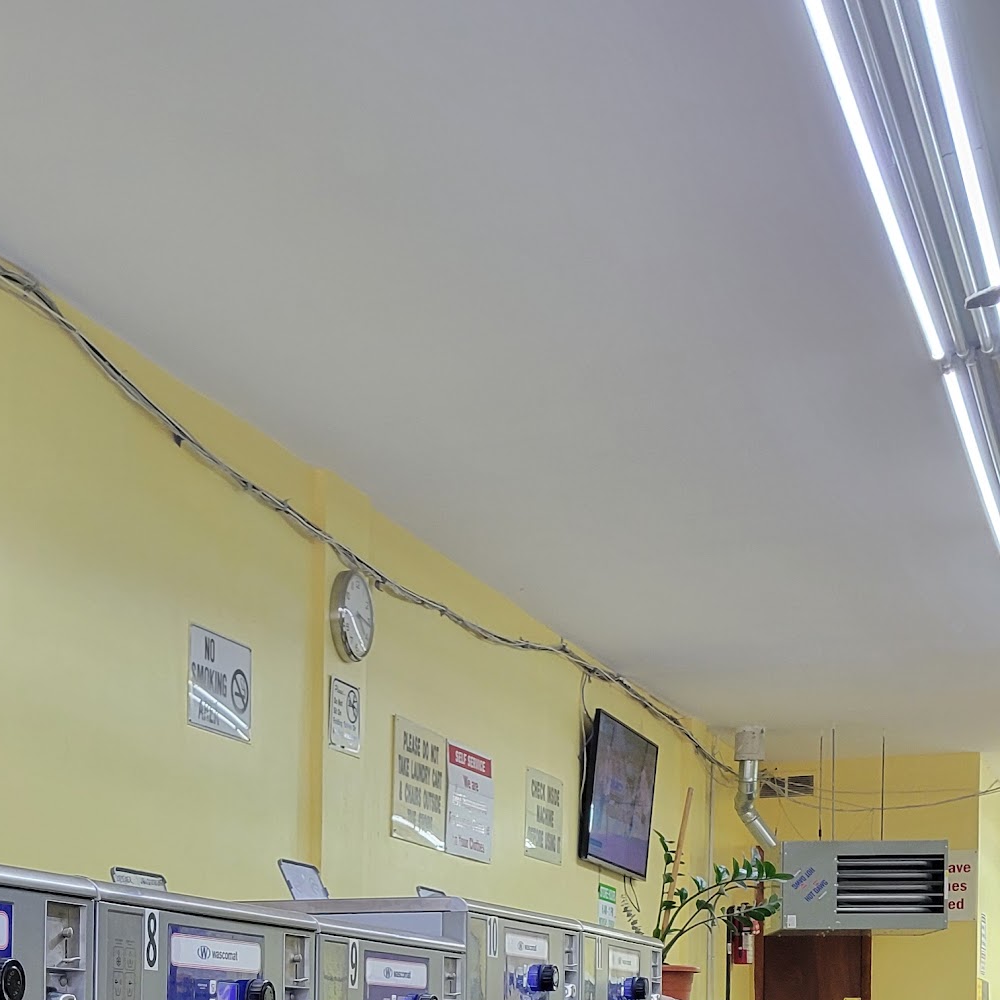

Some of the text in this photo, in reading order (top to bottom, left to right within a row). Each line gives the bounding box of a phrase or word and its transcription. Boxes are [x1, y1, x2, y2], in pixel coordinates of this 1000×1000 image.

[204, 636, 216, 662] NO
[191, 661, 228, 698] SMOKING
[403, 730, 440, 765] PLEASE DO NOT
[455, 750, 486, 773] SELF SERVICE
[948, 864, 971, 873] ave
[948, 898, 964, 910] ed
[146, 912, 157, 968] 8
[488, 917, 498, 957] 10
[212, 950, 238, 961] wascomat
[350, 941, 358, 987] 9
